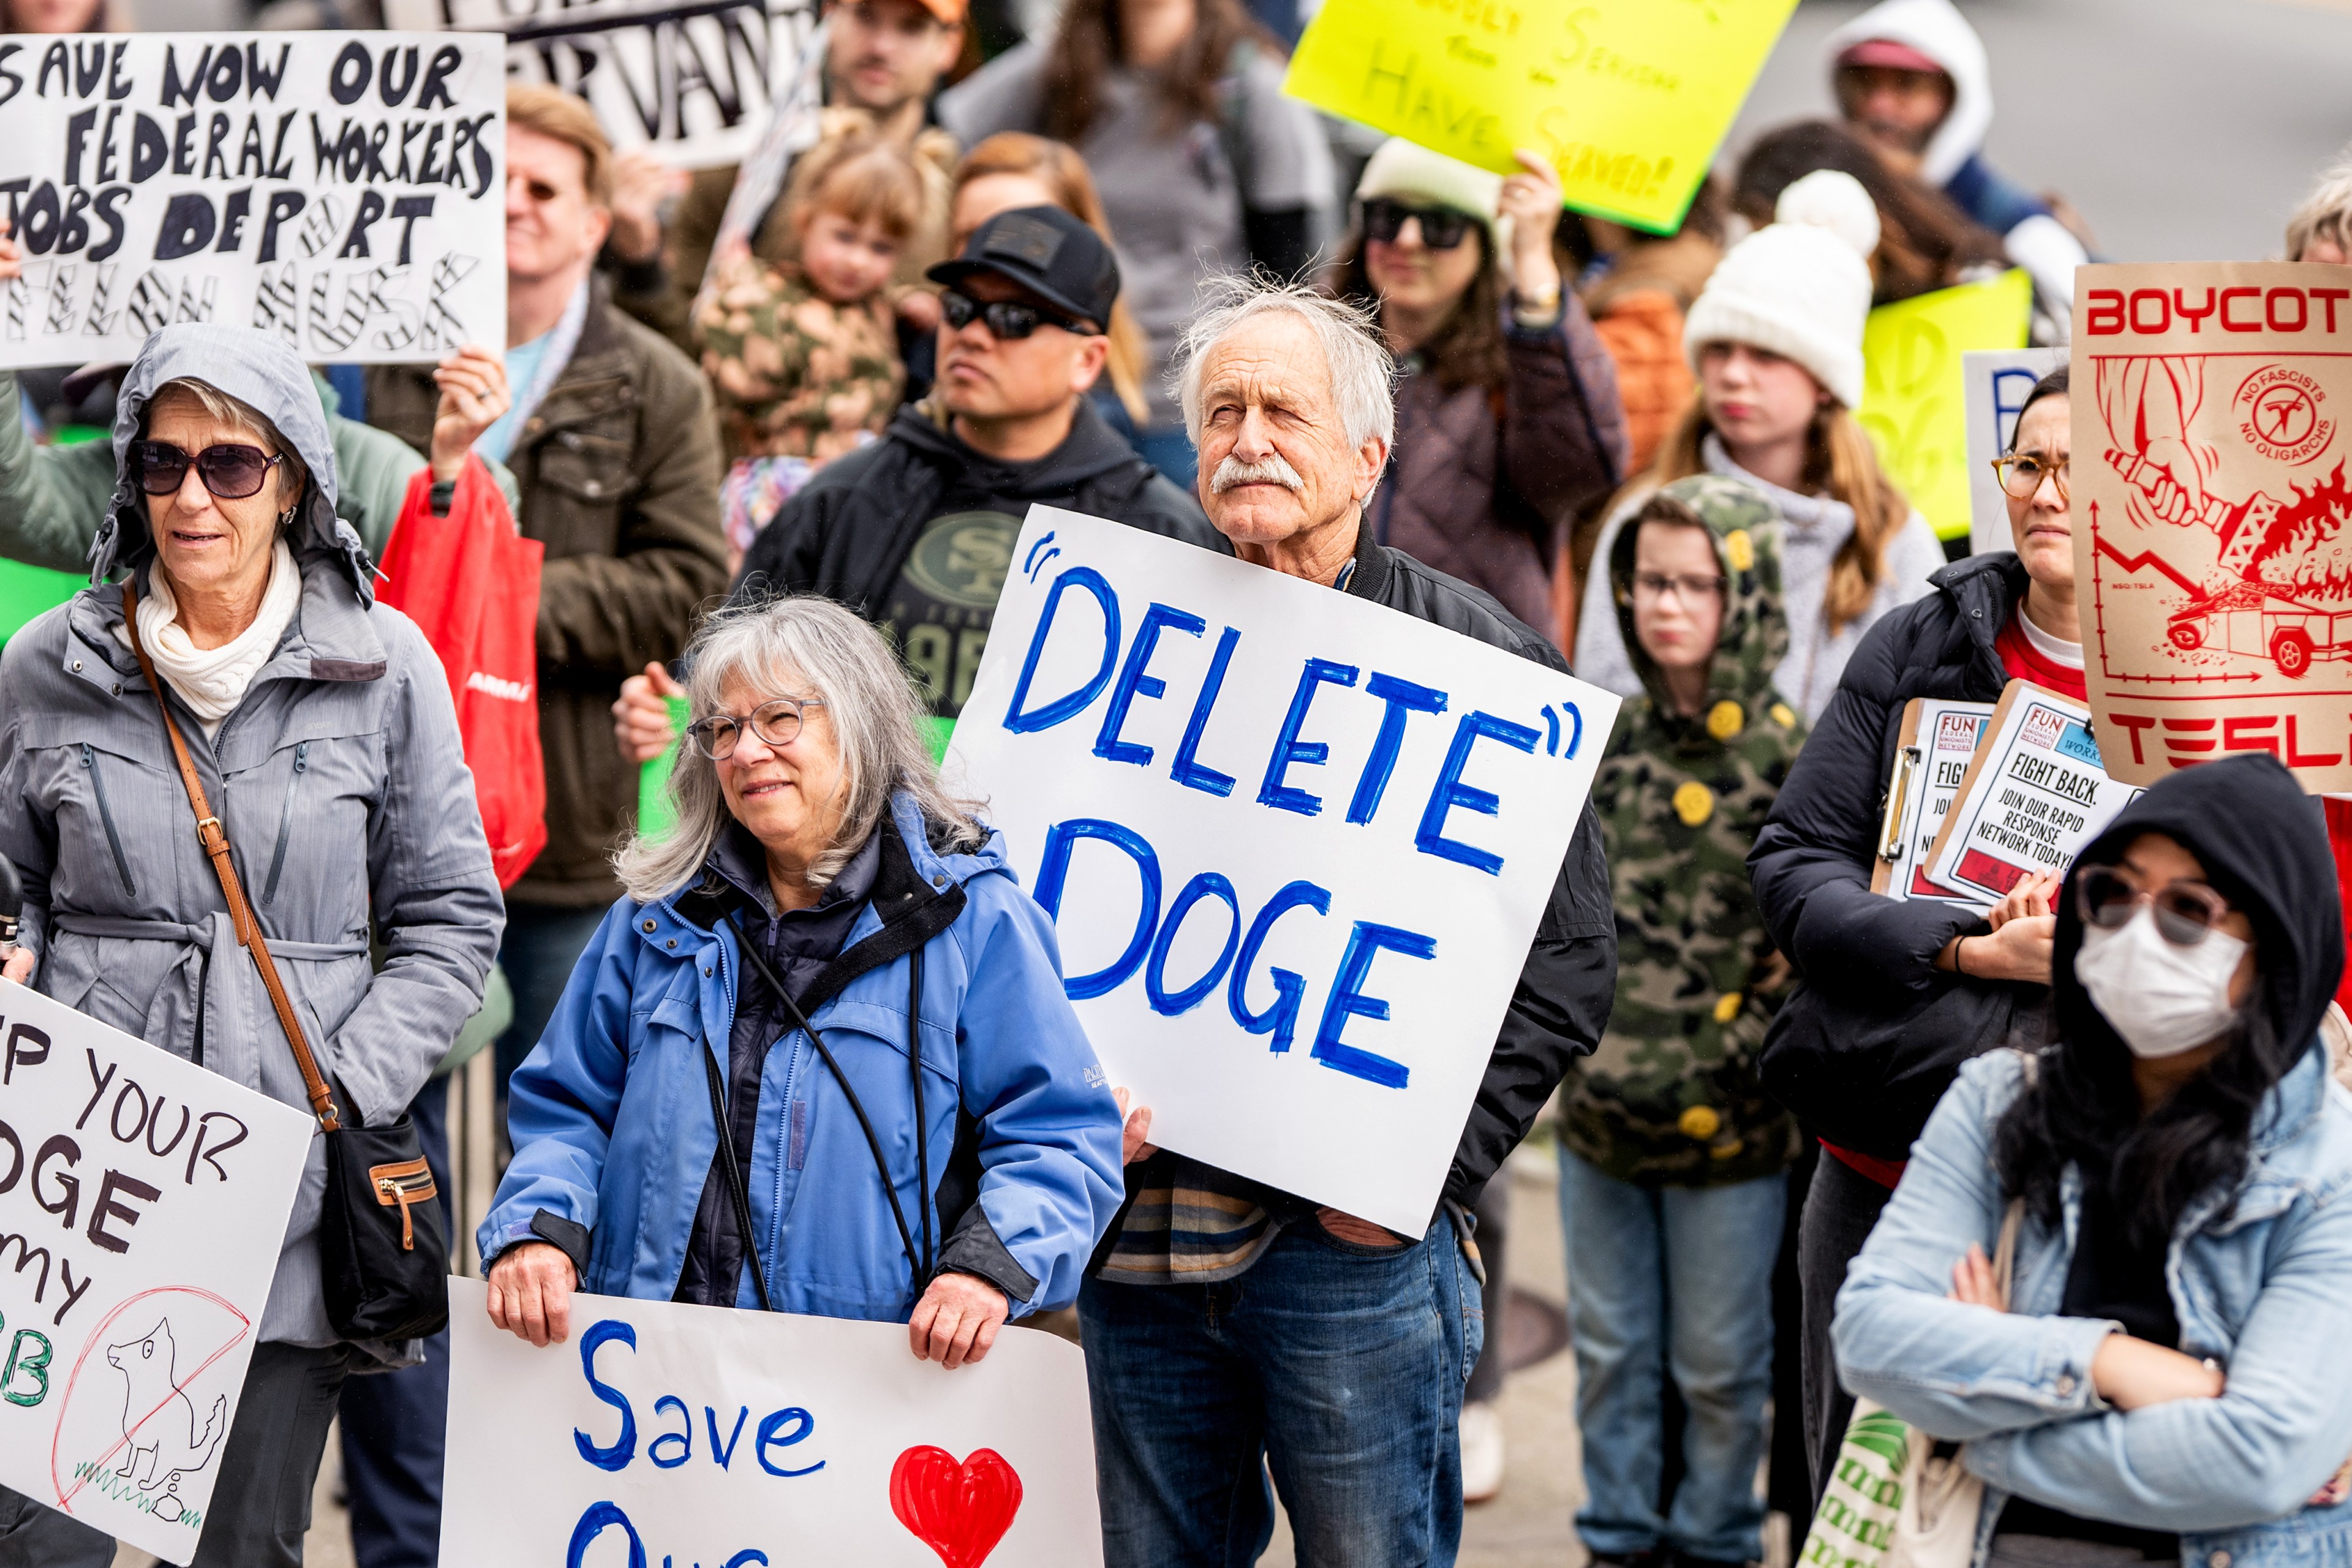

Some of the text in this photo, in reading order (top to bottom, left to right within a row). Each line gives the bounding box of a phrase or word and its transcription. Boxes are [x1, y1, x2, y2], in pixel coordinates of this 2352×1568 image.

[160, 41, 293, 108] NOW
[330, 40, 462, 110] OUR
[64, 105, 496, 200] FEDERAL WORKERS
[252, 251, 480, 354] MUSK
[2241, 369, 2326, 404] NO FASCISTS
[2239, 419, 2330, 461] NO OLIGARCHS
[1942, 717, 1975, 733] FUN
[2022, 733, 2051, 748] NETWORK
[2025, 727, 2054, 742] UNIONISTS
[2027, 722, 2056, 736] FEDERAL
[2030, 709, 2063, 732] FUN
[2108, 712, 2352, 768] TESL
[2010, 752, 2100, 805] FIGHT BACK.
[1998, 787, 2084, 833] JOIN OUR RAPID
[2002, 810, 2062, 845] RESPONSE
[1977, 821, 2074, 871] NETWORK TODAY!
[1031, 818, 1438, 1090] DOGE
[75, 1048, 249, 1185] YOUR
[573, 1319, 826, 1477] Save
